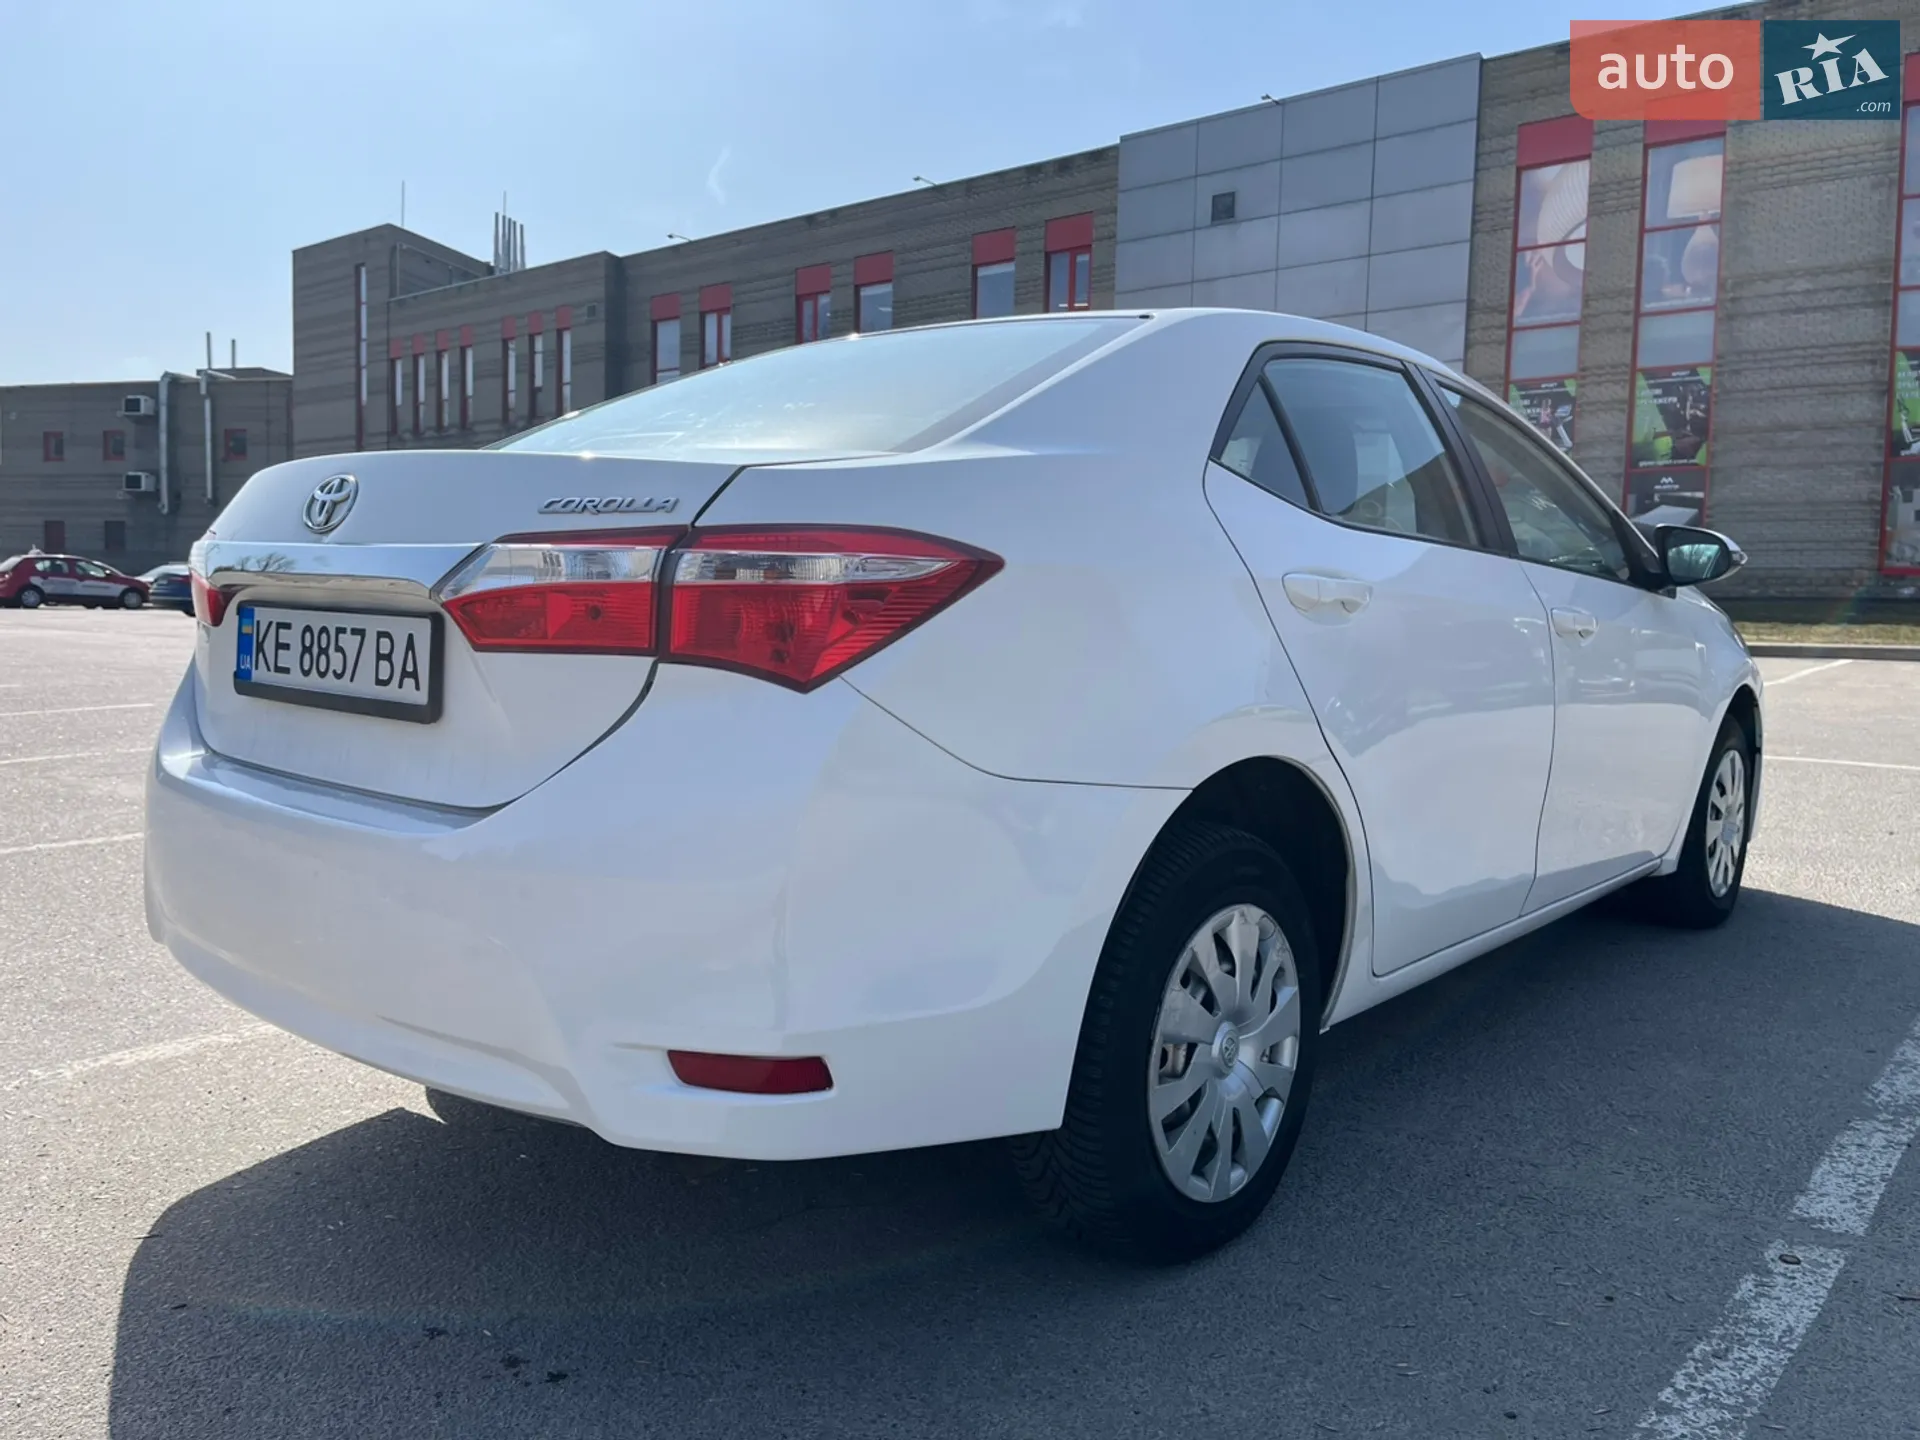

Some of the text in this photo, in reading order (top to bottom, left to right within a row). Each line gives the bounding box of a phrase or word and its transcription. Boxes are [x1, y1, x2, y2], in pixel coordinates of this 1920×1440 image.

[537, 496, 680, 515] COROLLA
[240, 654, 251, 670] UA
[254, 619, 420, 692] KE 8857 BA
